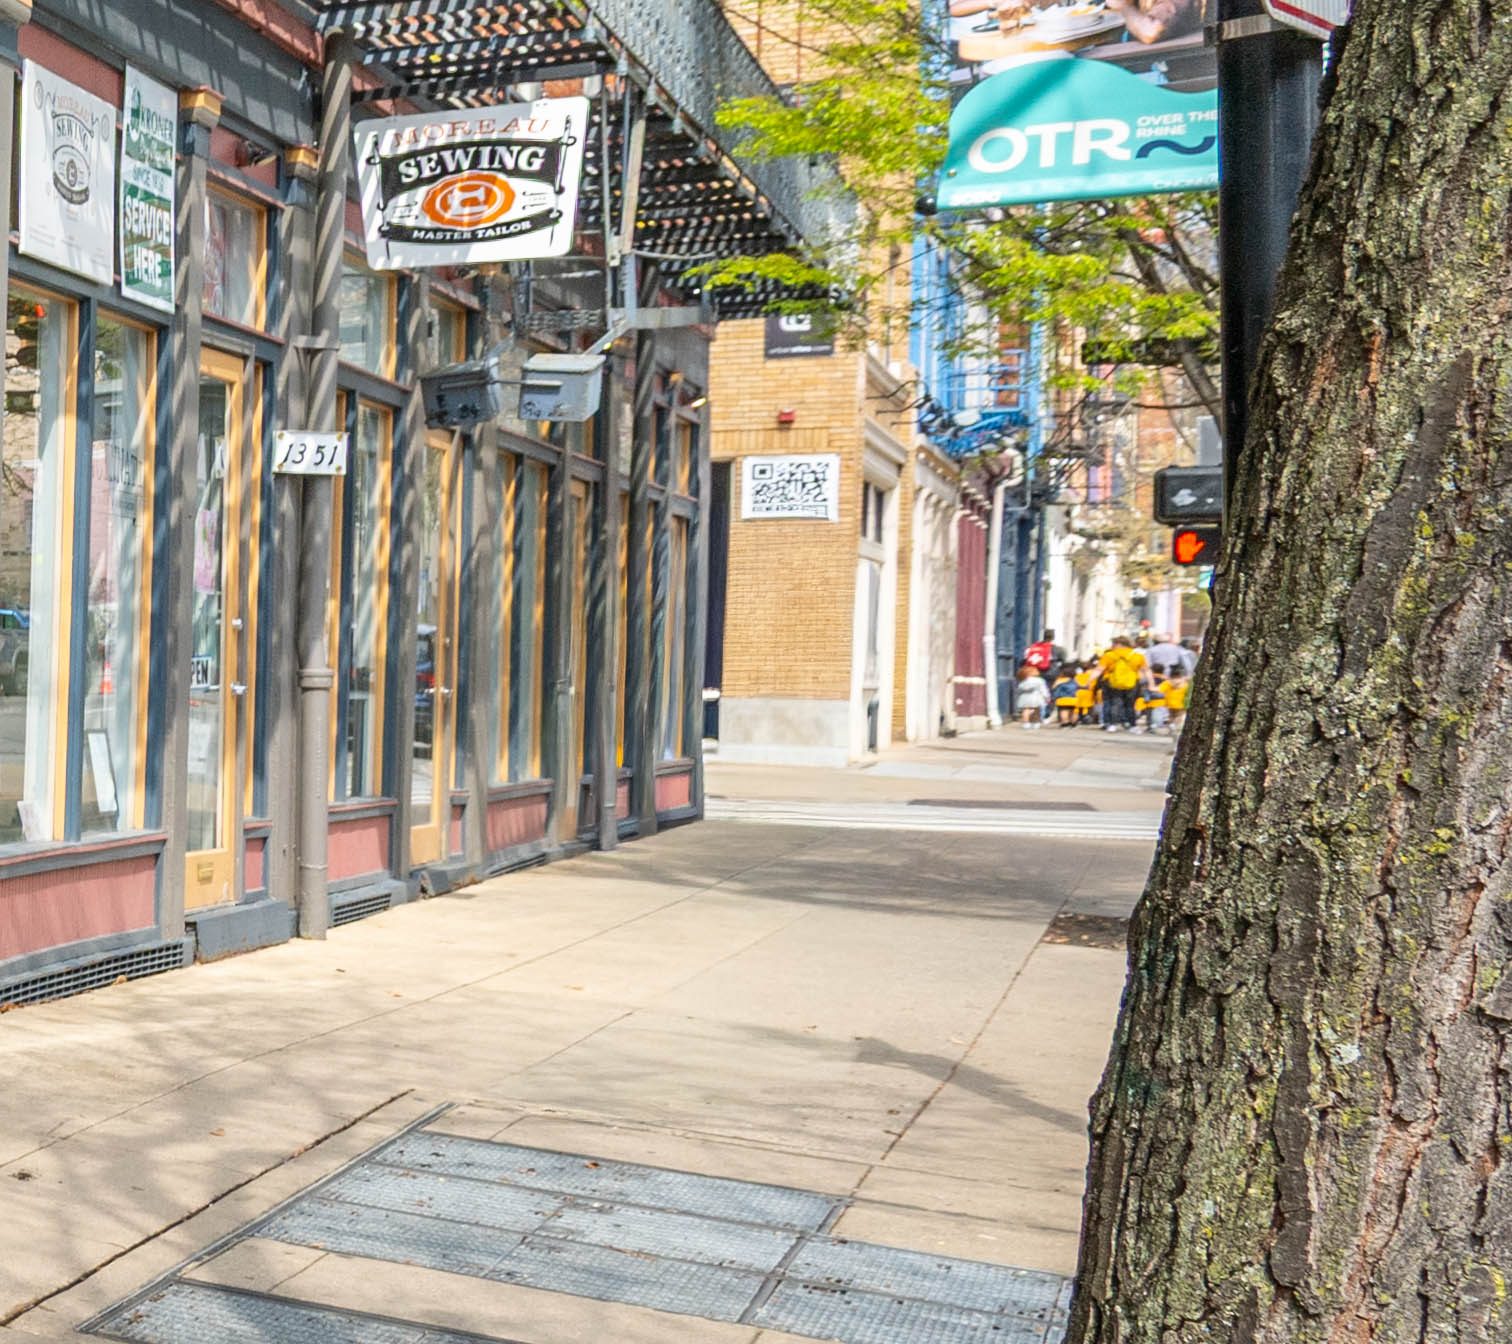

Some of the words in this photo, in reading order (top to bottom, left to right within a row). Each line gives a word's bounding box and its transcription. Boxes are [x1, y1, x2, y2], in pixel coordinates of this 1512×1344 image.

[394, 118, 551, 147] MOREAU
[1135, 124, 1187, 138] RHINE
[1136, 113, 1185, 128] OVER
[1187, 109, 1218, 123] THE
[56, 120, 89, 153] SEWING
[967, 119, 1132, 173] OTR
[398, 146, 547, 183] SEWING
[125, 194, 171, 244] SERVICE
[413, 229, 472, 240] MASTER
[476, 221, 532, 239] TAILOR
[134, 245, 162, 287] HERE
